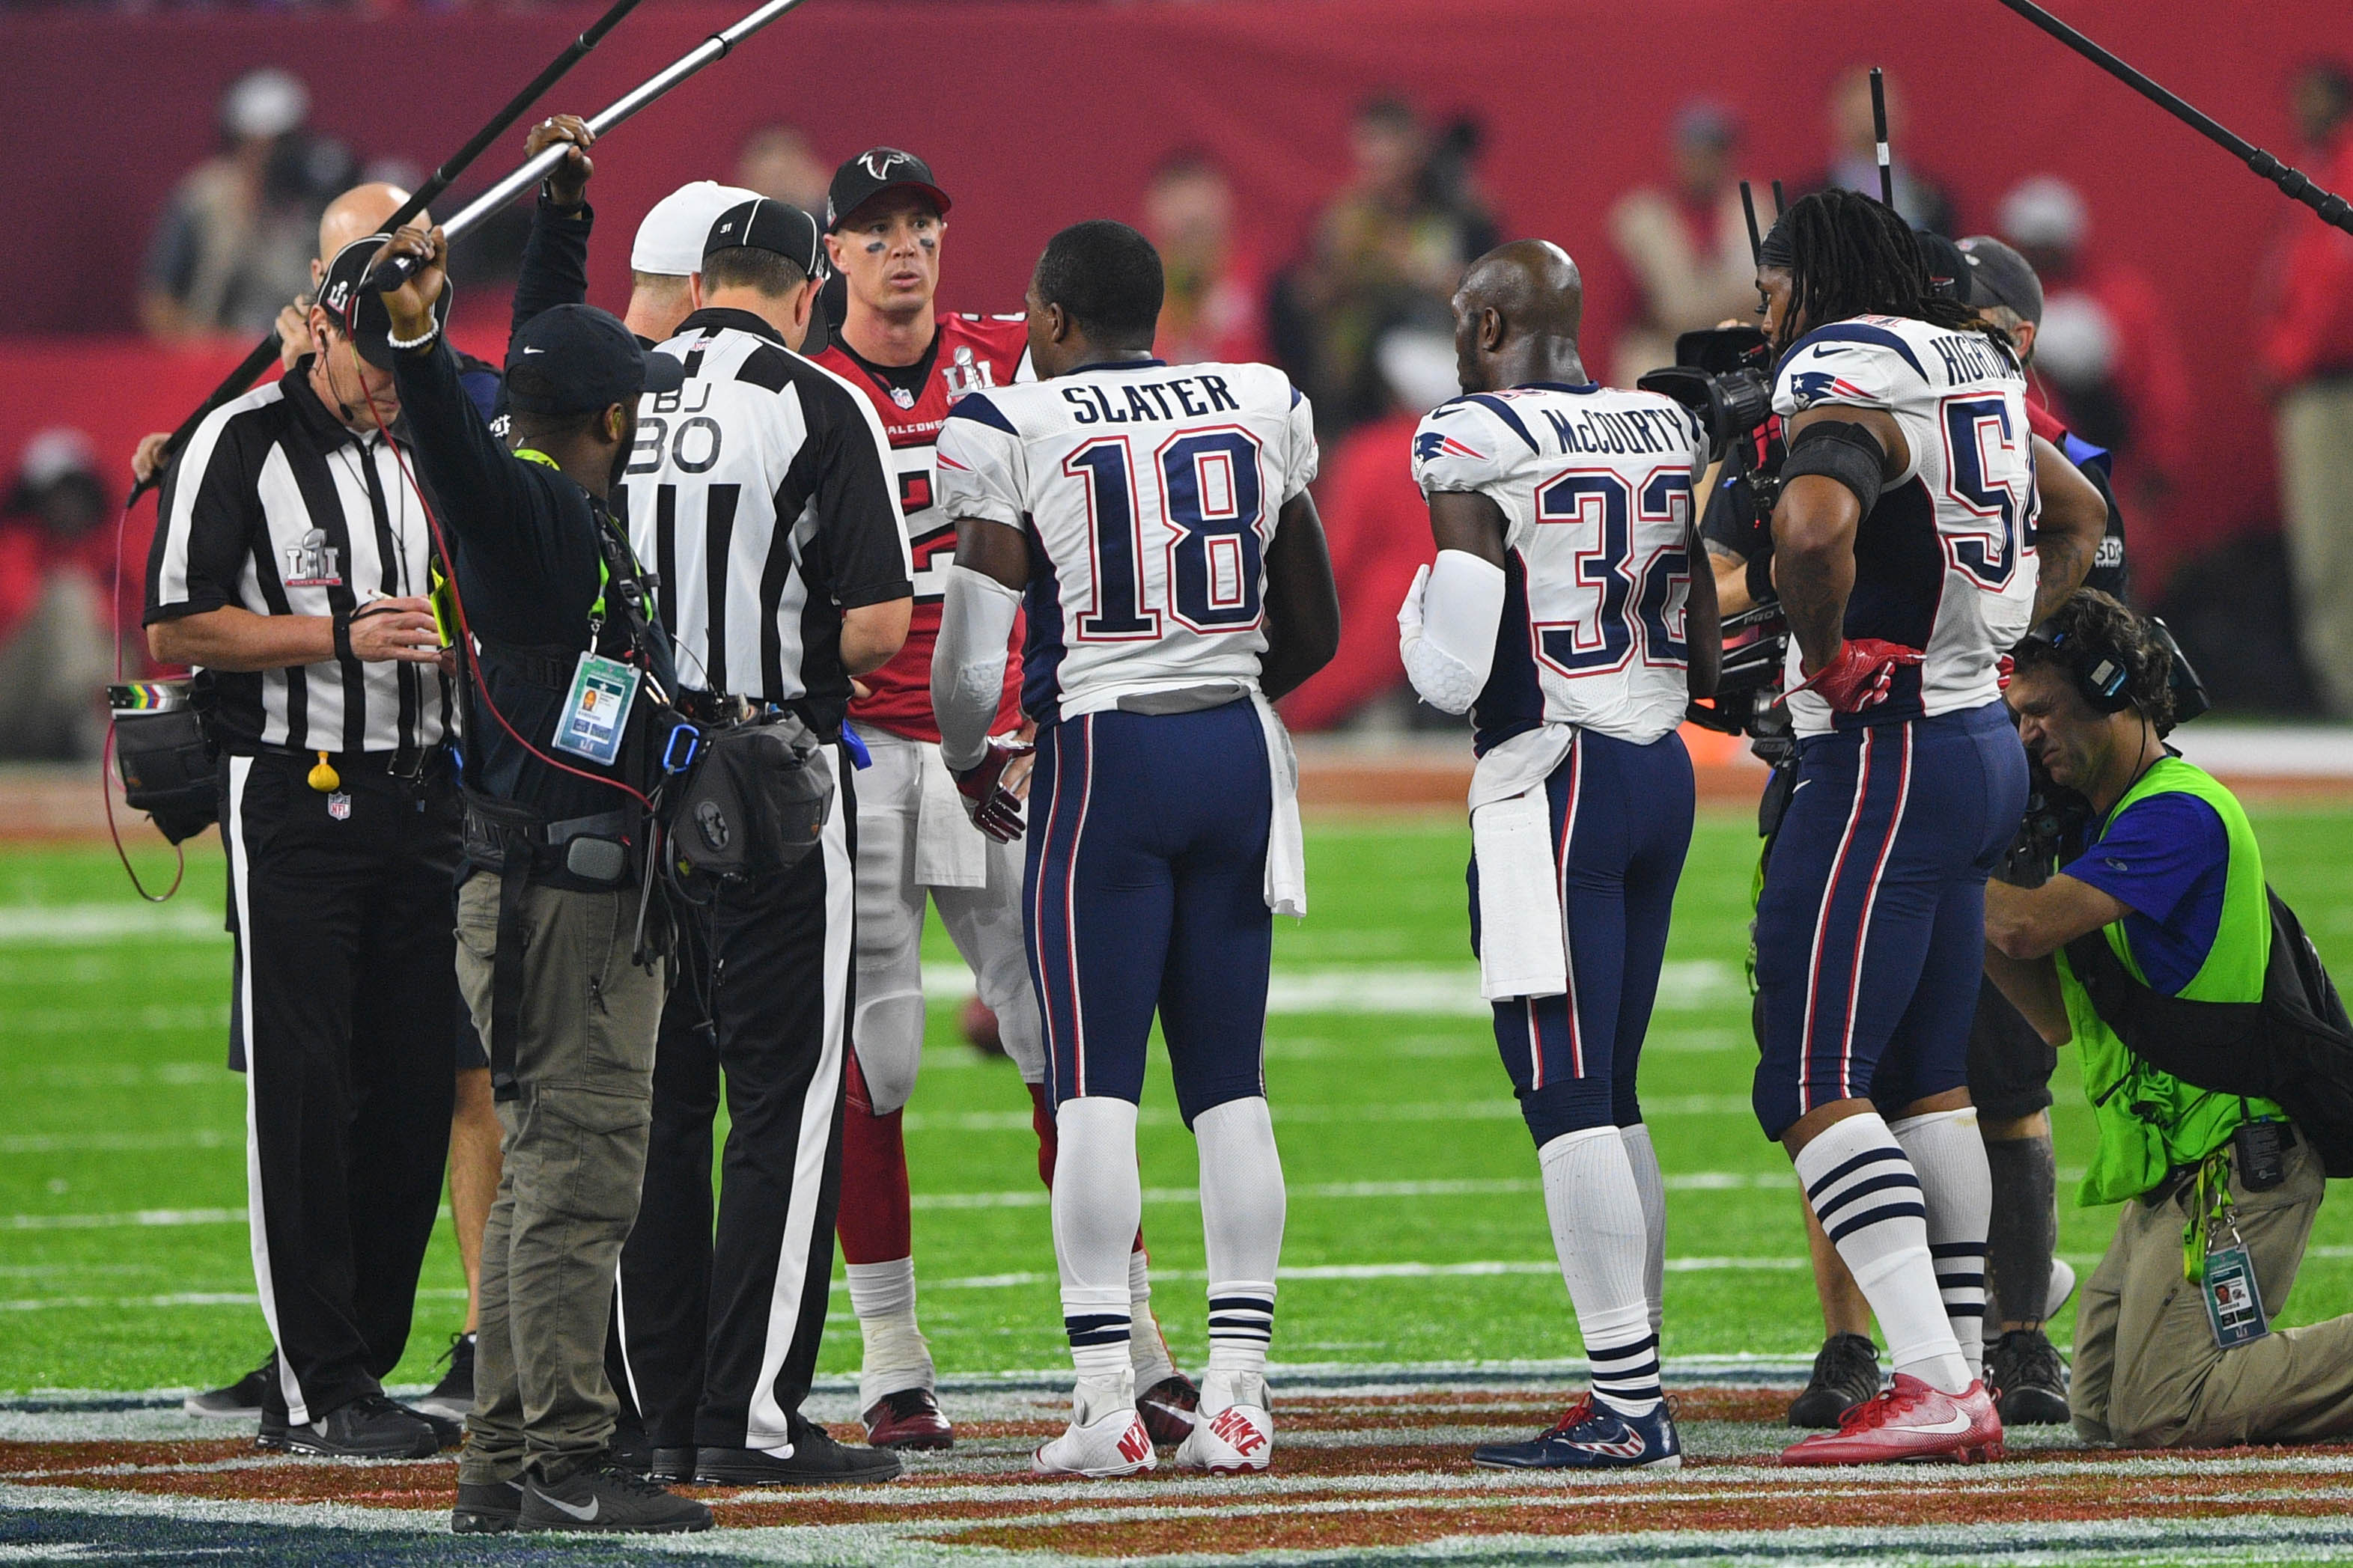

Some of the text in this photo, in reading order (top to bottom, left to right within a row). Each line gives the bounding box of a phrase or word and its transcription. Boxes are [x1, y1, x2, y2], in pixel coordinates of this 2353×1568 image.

[652, 383, 712, 413] BJ
[1061, 375, 1241, 424] SLATER
[884, 420, 943, 435] ALCONS
[1540, 408, 1690, 454] McCOURTY
[1062, 424, 1266, 641] 18
[1532, 466, 1692, 680] 32
[1208, 1407, 1267, 1457] NIKE
